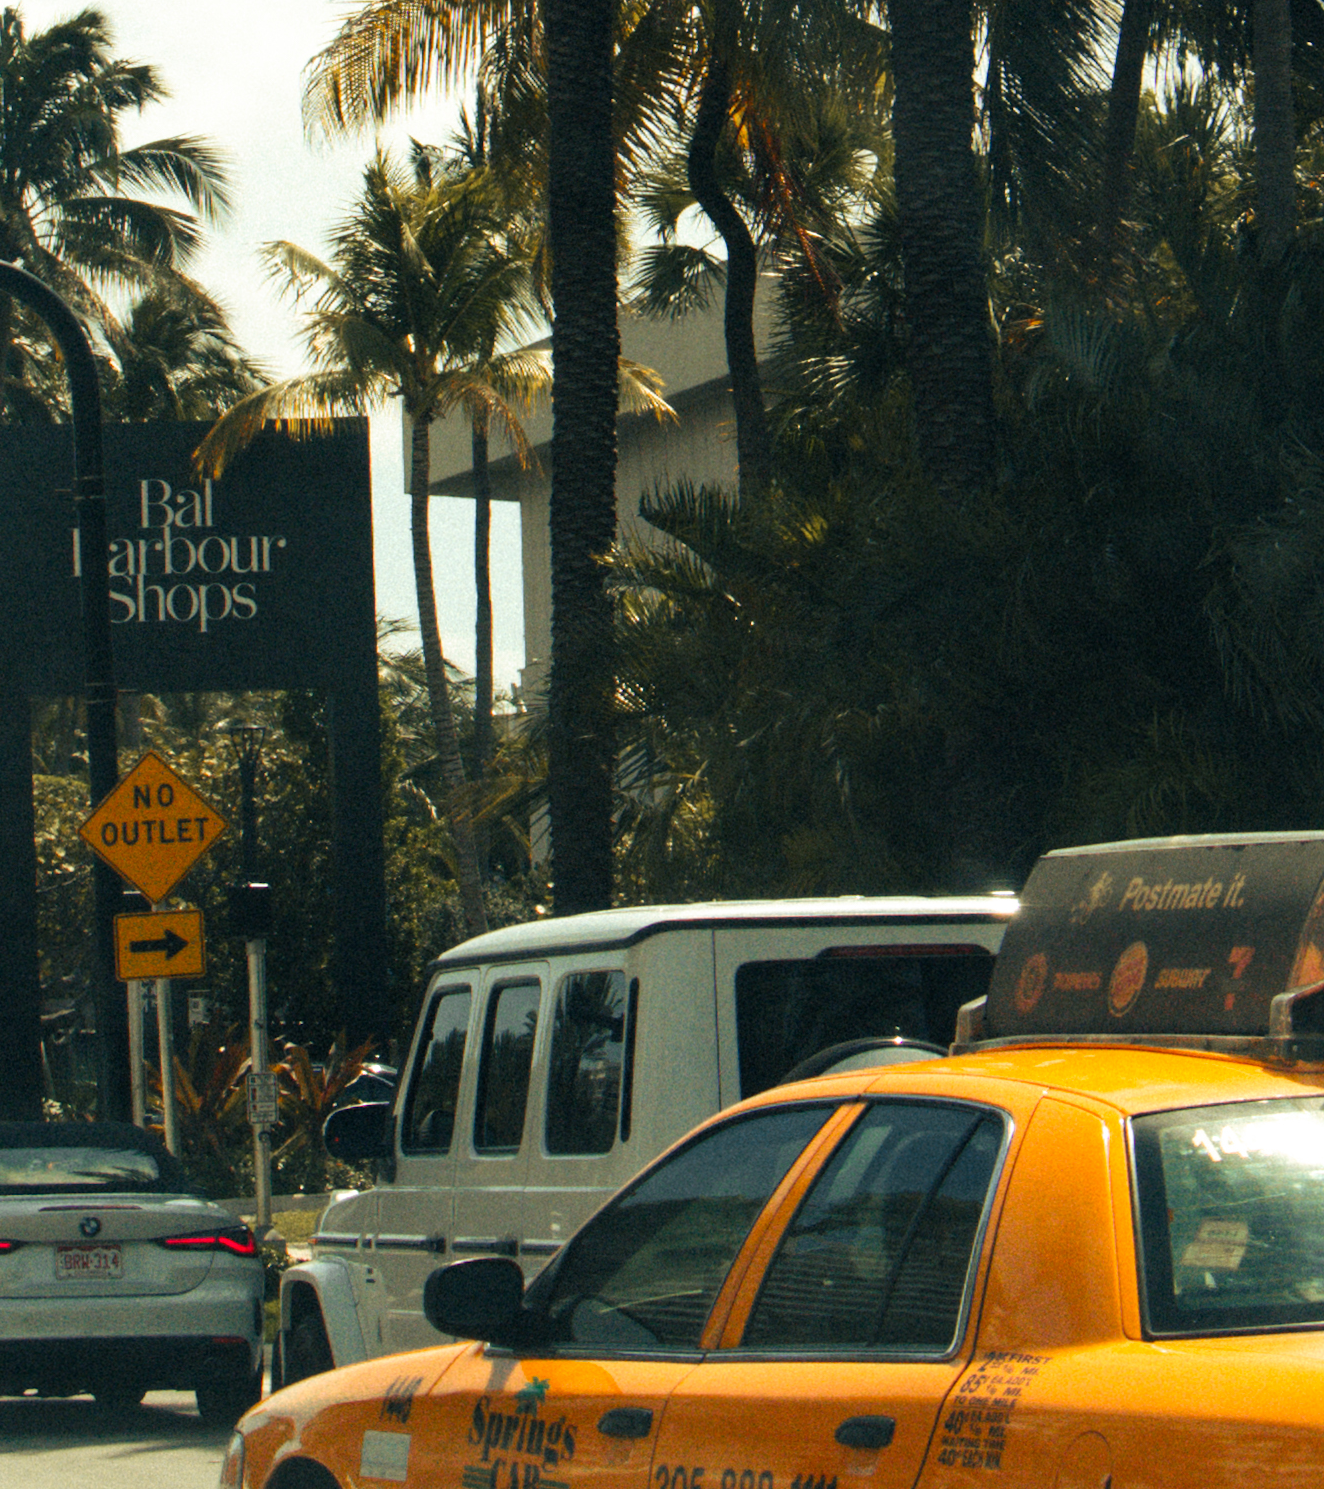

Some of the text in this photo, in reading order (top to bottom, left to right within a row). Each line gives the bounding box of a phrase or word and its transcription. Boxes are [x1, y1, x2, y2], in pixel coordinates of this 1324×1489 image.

[139, 478, 214, 528] Bal
[72, 526, 287, 577] arbour
[108, 574, 258, 633] Shops
[133, 783, 175, 809] NO
[100, 818, 210, 847] OUTLET
[1119, 877, 1223, 911] Postmate
[1154, 968, 1212, 989] SUBWAY
[468, 1395, 577, 1472] Springs
